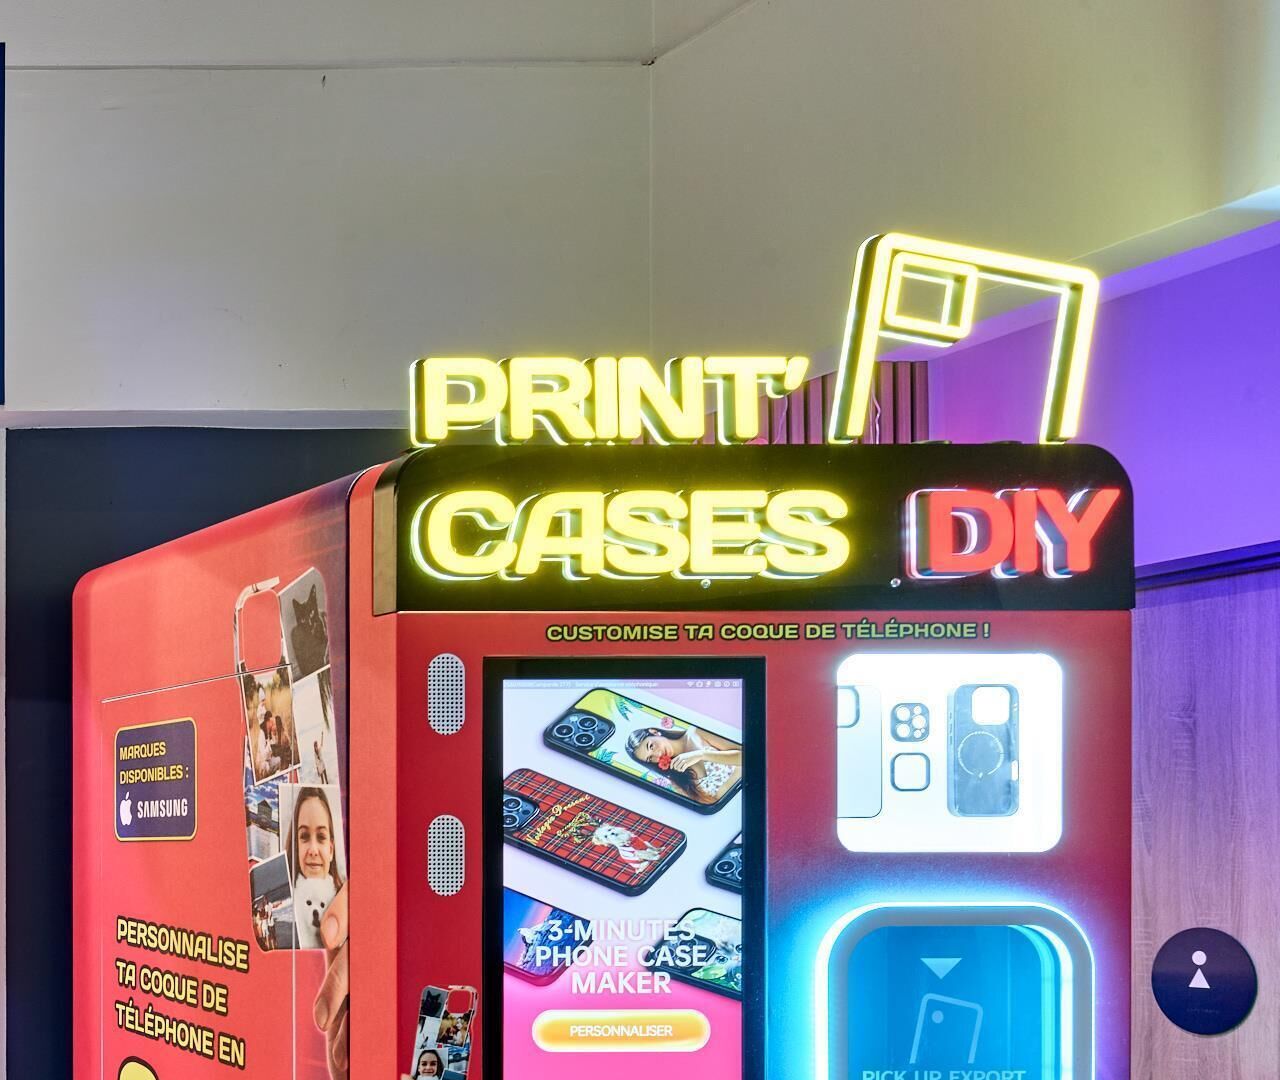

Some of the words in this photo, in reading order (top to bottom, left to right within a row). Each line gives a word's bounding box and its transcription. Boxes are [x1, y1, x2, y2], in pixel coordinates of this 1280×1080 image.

[410, 355, 810, 445] PRINT'
[412, 488, 850, 581] CASES
[905, 487, 1121, 581] DIY
[546, 625, 679, 642] CUSTOMISE
[685, 625, 714, 641] TA
[719, 624, 801, 642] COQUE
[807, 623, 838, 640] DE
[842, 619, 977, 641] TÉLÉPHONE
[982, 621, 992, 639] !
[119, 741, 167, 761] MARQUES
[119, 765, 183, 786] DISPONIBLES
[137, 797, 188, 819] SAMSUNG
[548, 919, 696, 942] 3-MINUTES
[116, 915, 250, 972] PERSONNALISE
[536, 945, 629, 967] PHONE
[637, 945, 707, 967] CASE
[115, 958, 137, 989] TA
[140, 965, 198, 1006] COQUE
[202, 982, 229, 1015] DE
[571, 971, 672, 994] MAKER
[115, 999, 214, 1057] TÉLÉPHONE
[218, 1035, 246, 1068] EN
[569, 1024, 673, 1038] PERSONNALISER
